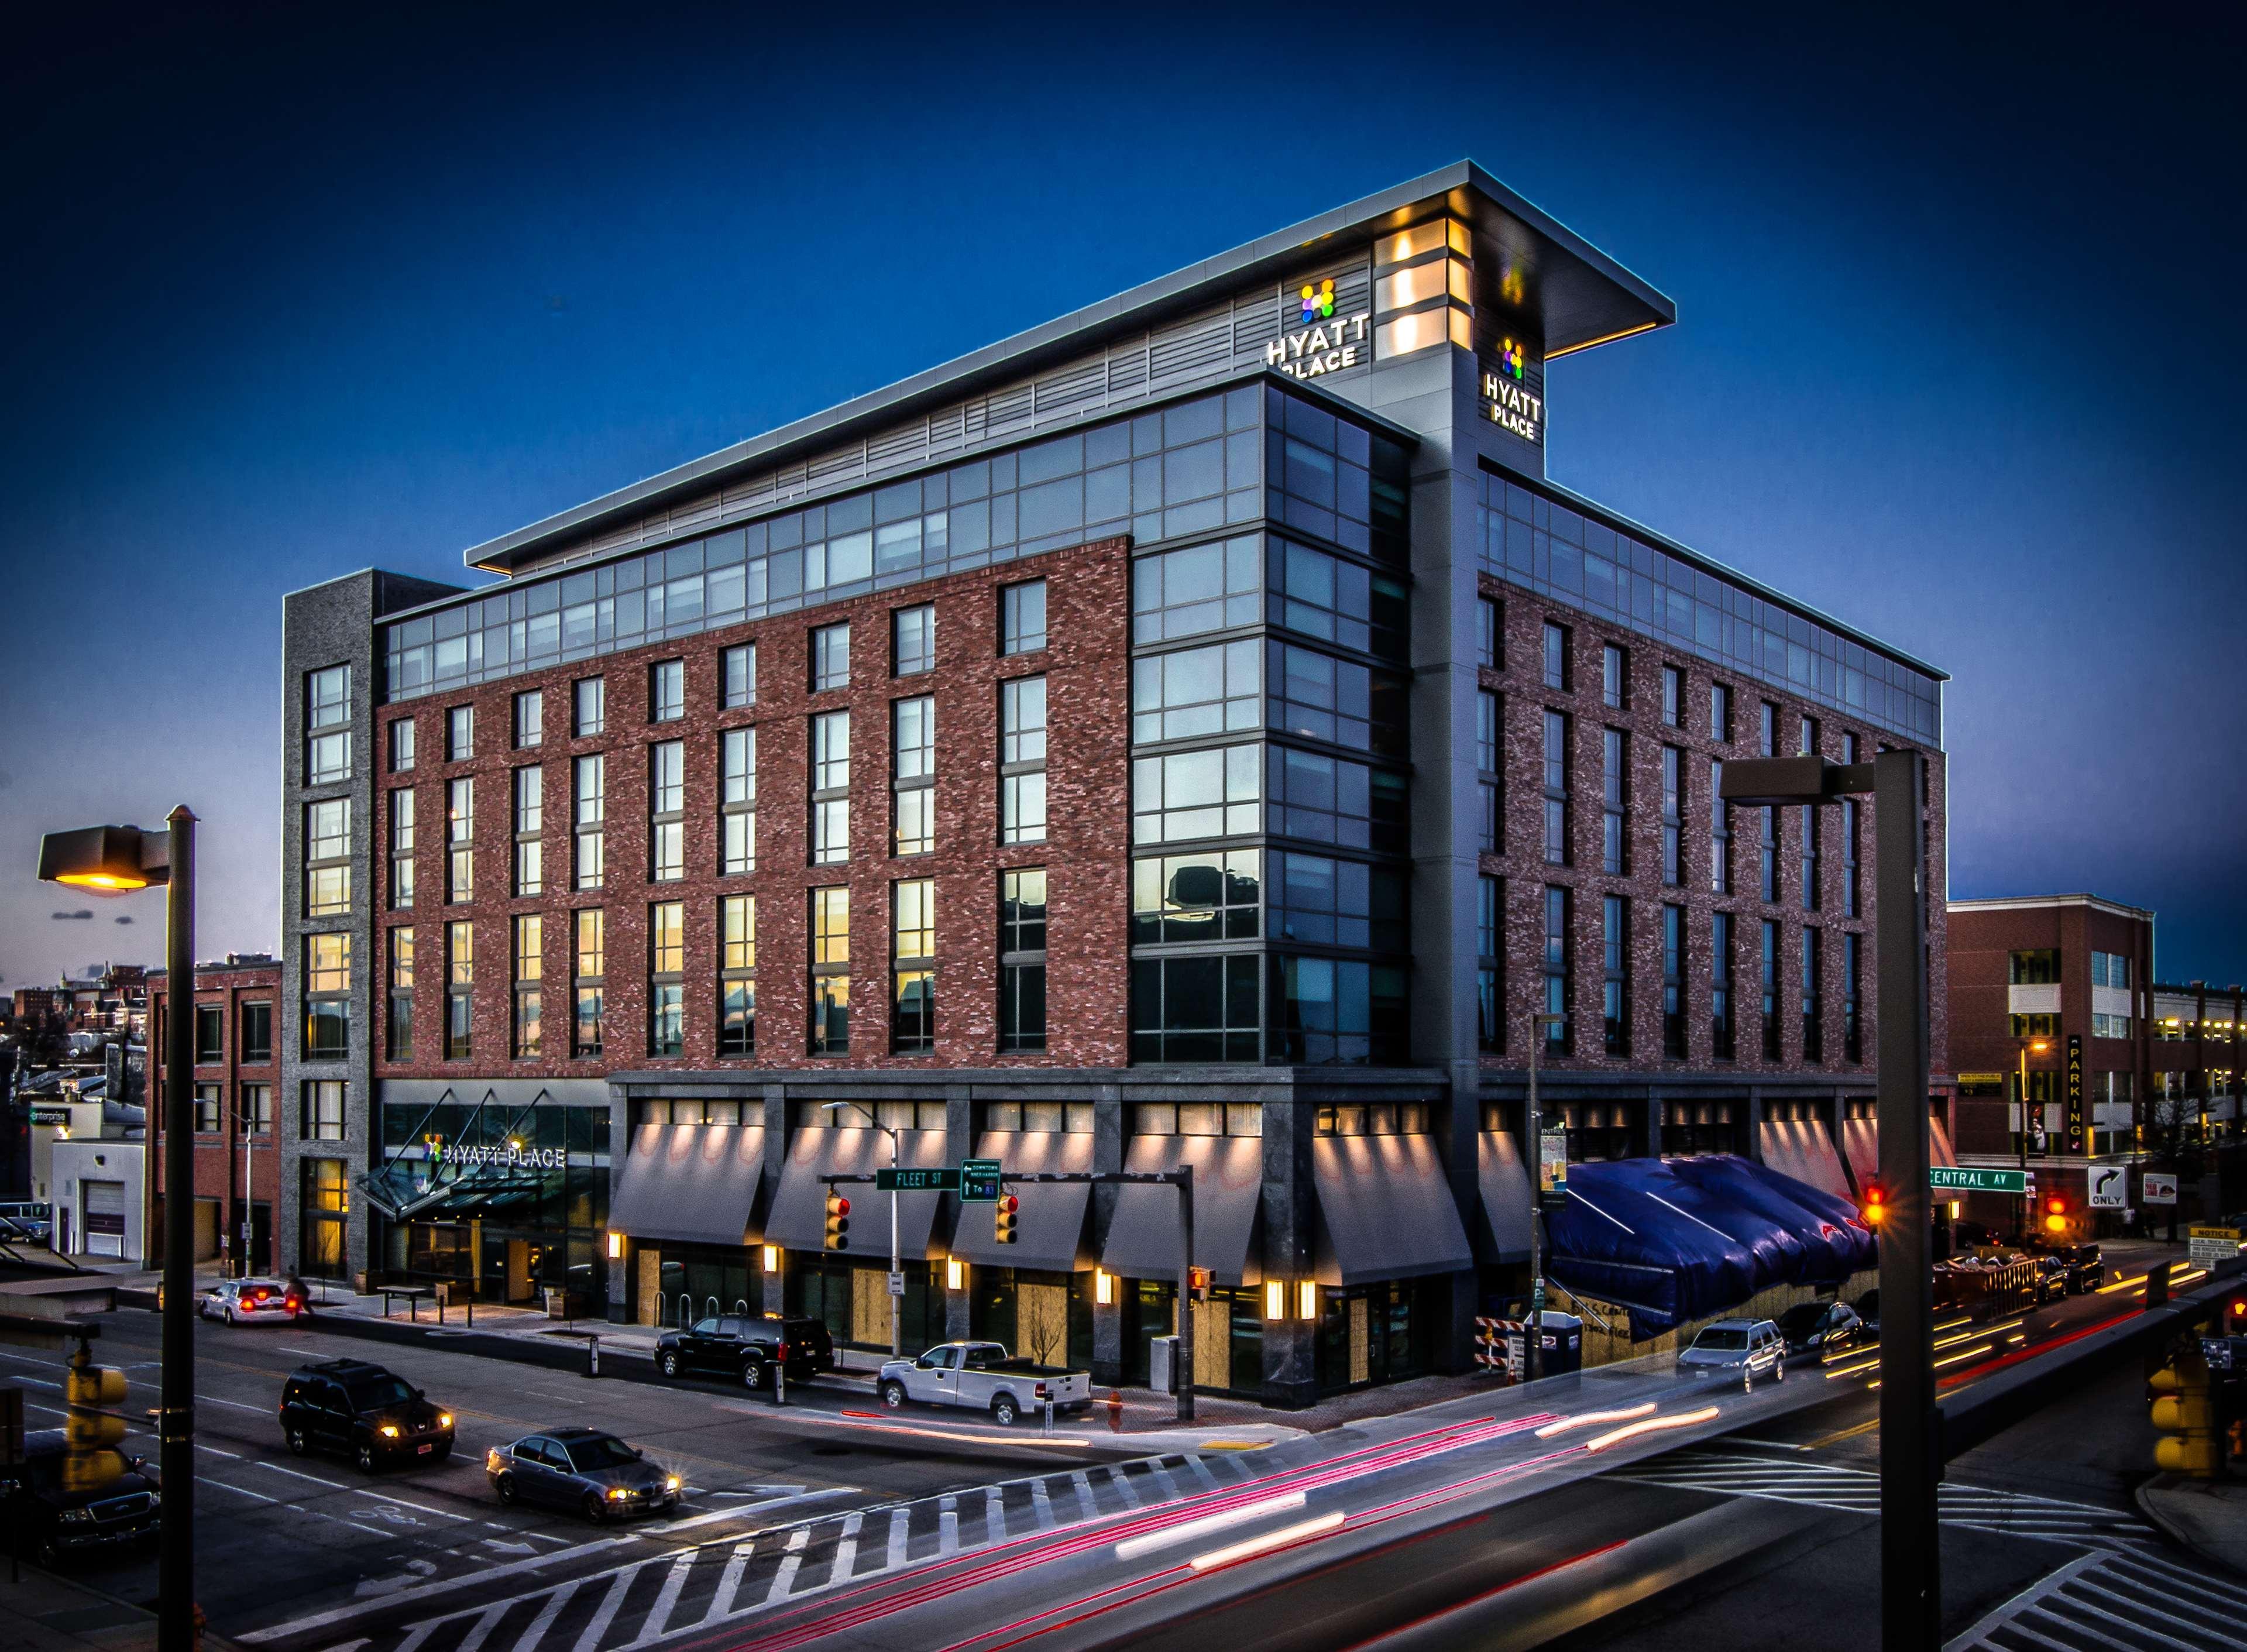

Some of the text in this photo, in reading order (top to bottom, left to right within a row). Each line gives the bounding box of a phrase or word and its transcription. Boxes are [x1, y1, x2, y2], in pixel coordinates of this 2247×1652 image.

[1268, 312, 1370, 366] HYATT
[1485, 373, 1541, 421] HYATT
[1492, 404, 1534, 439] PLACE
[2070, 1048, 2081, 1135] PARKING
[29, 1111, 65, 1123] enterprise
[448, 1145, 565, 1168] HYATT PLACE
[896, 1173, 942, 1186] FLEET ST
[1994, 1174, 2006, 1184] AV
[985, 1186, 994, 1194] 83
[2093, 1196, 2121, 1204] ONLY
